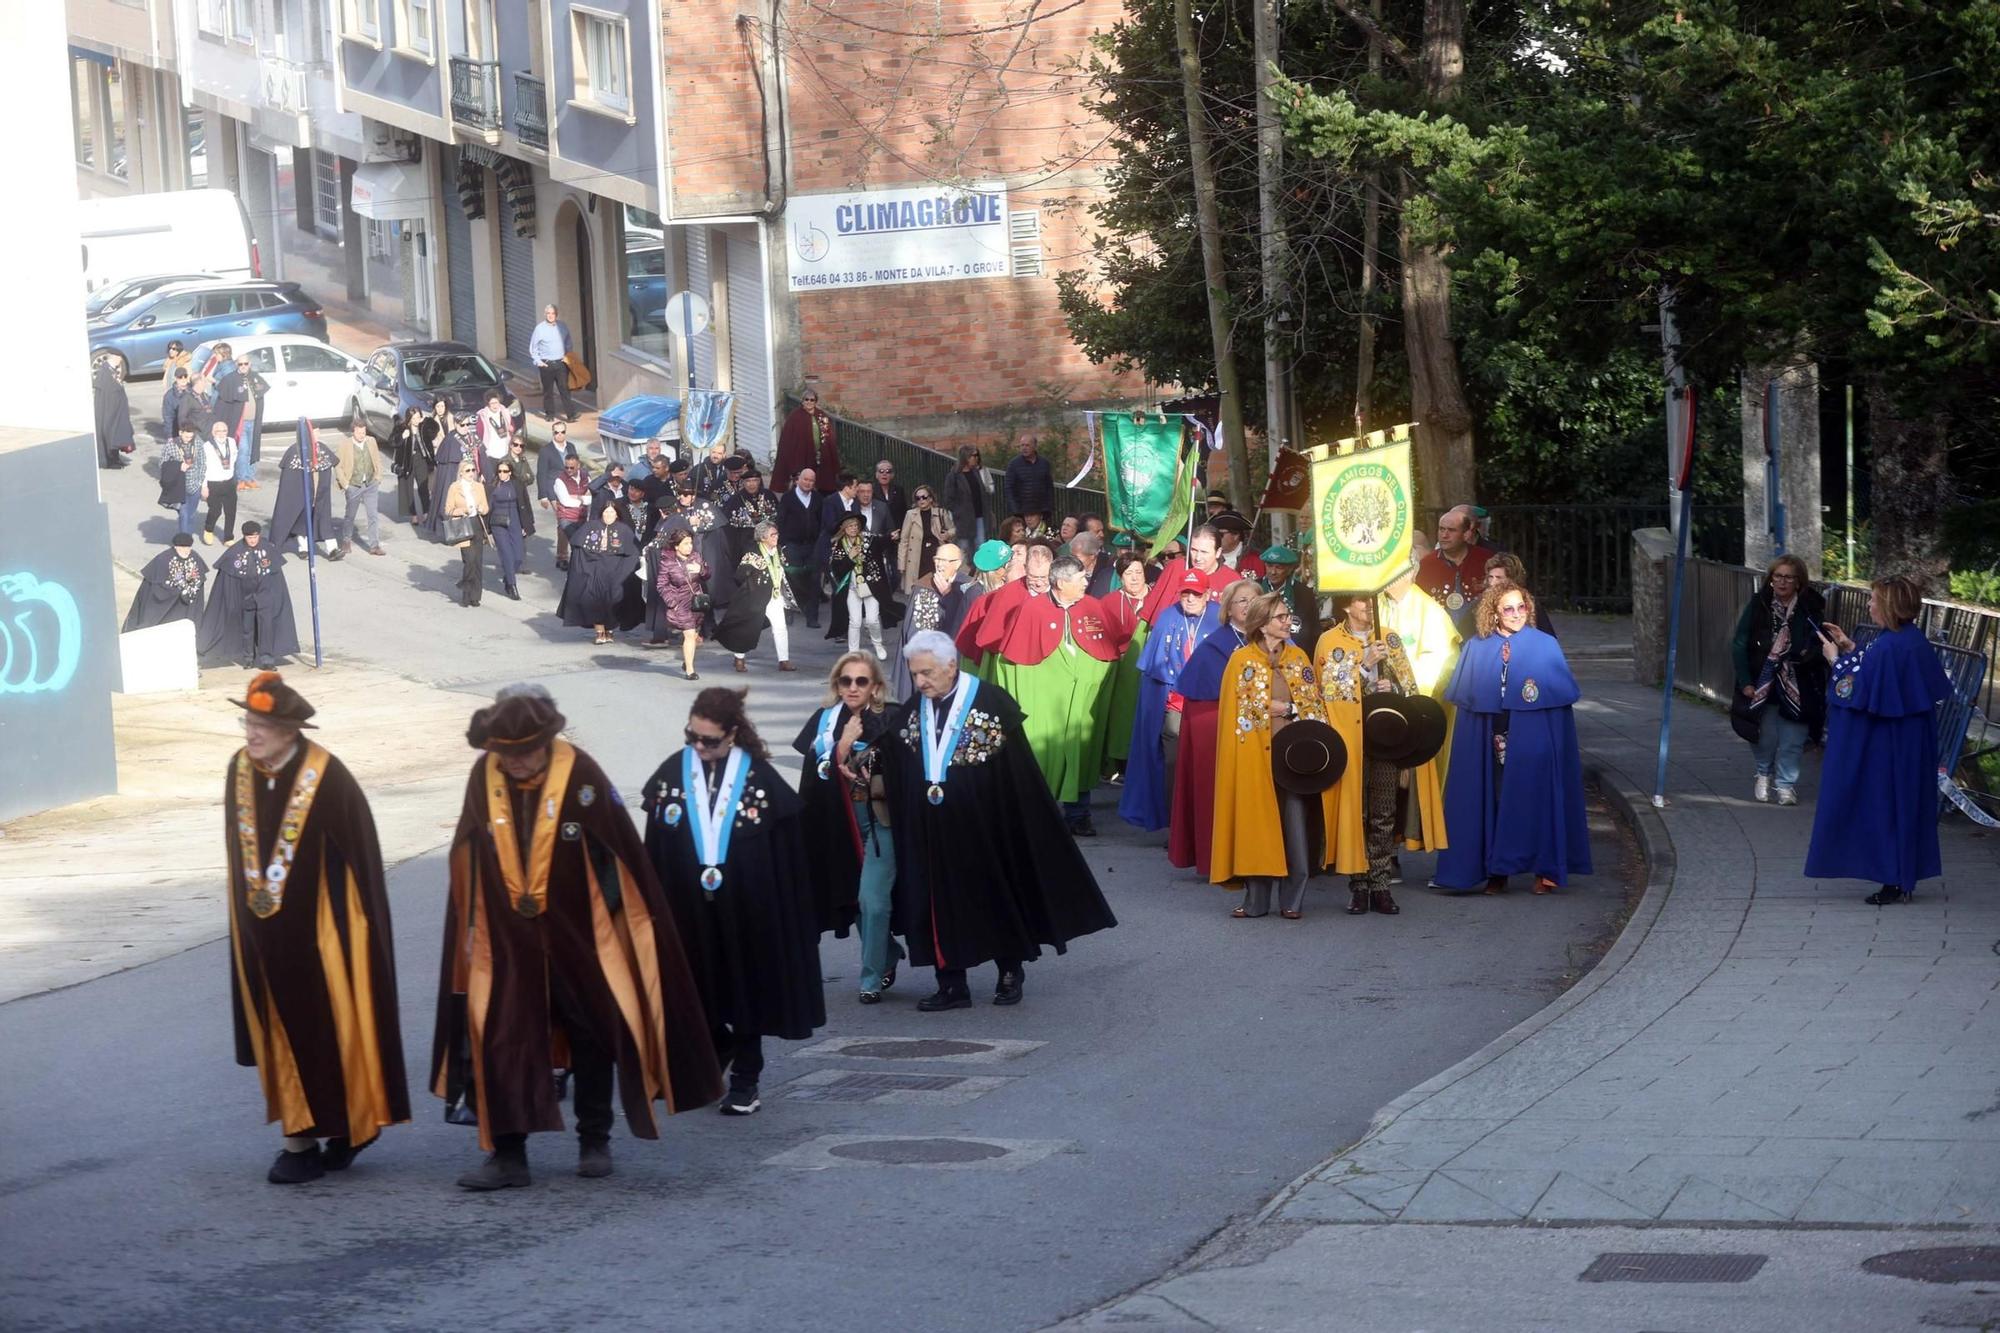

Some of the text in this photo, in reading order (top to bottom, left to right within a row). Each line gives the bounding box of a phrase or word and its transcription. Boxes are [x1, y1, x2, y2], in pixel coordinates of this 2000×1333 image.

[836, 195, 1001, 233] CLIMAGROVE
[829, 273, 841, 283] 04
[843, 272, 855, 283] 33
[856, 271, 867, 282] 86
[875, 269, 908, 281] MONTE
[910, 268, 923, 279] DA
[964, 264, 970, 274] O
[973, 262, 1004, 274] GROVE
[1340, 466, 1382, 486] AMIGOS
[1386, 474, 1399, 493] DEL
[1393, 501, 1405, 539] OLIVO
[1349, 549, 1388, 562] BAENA
